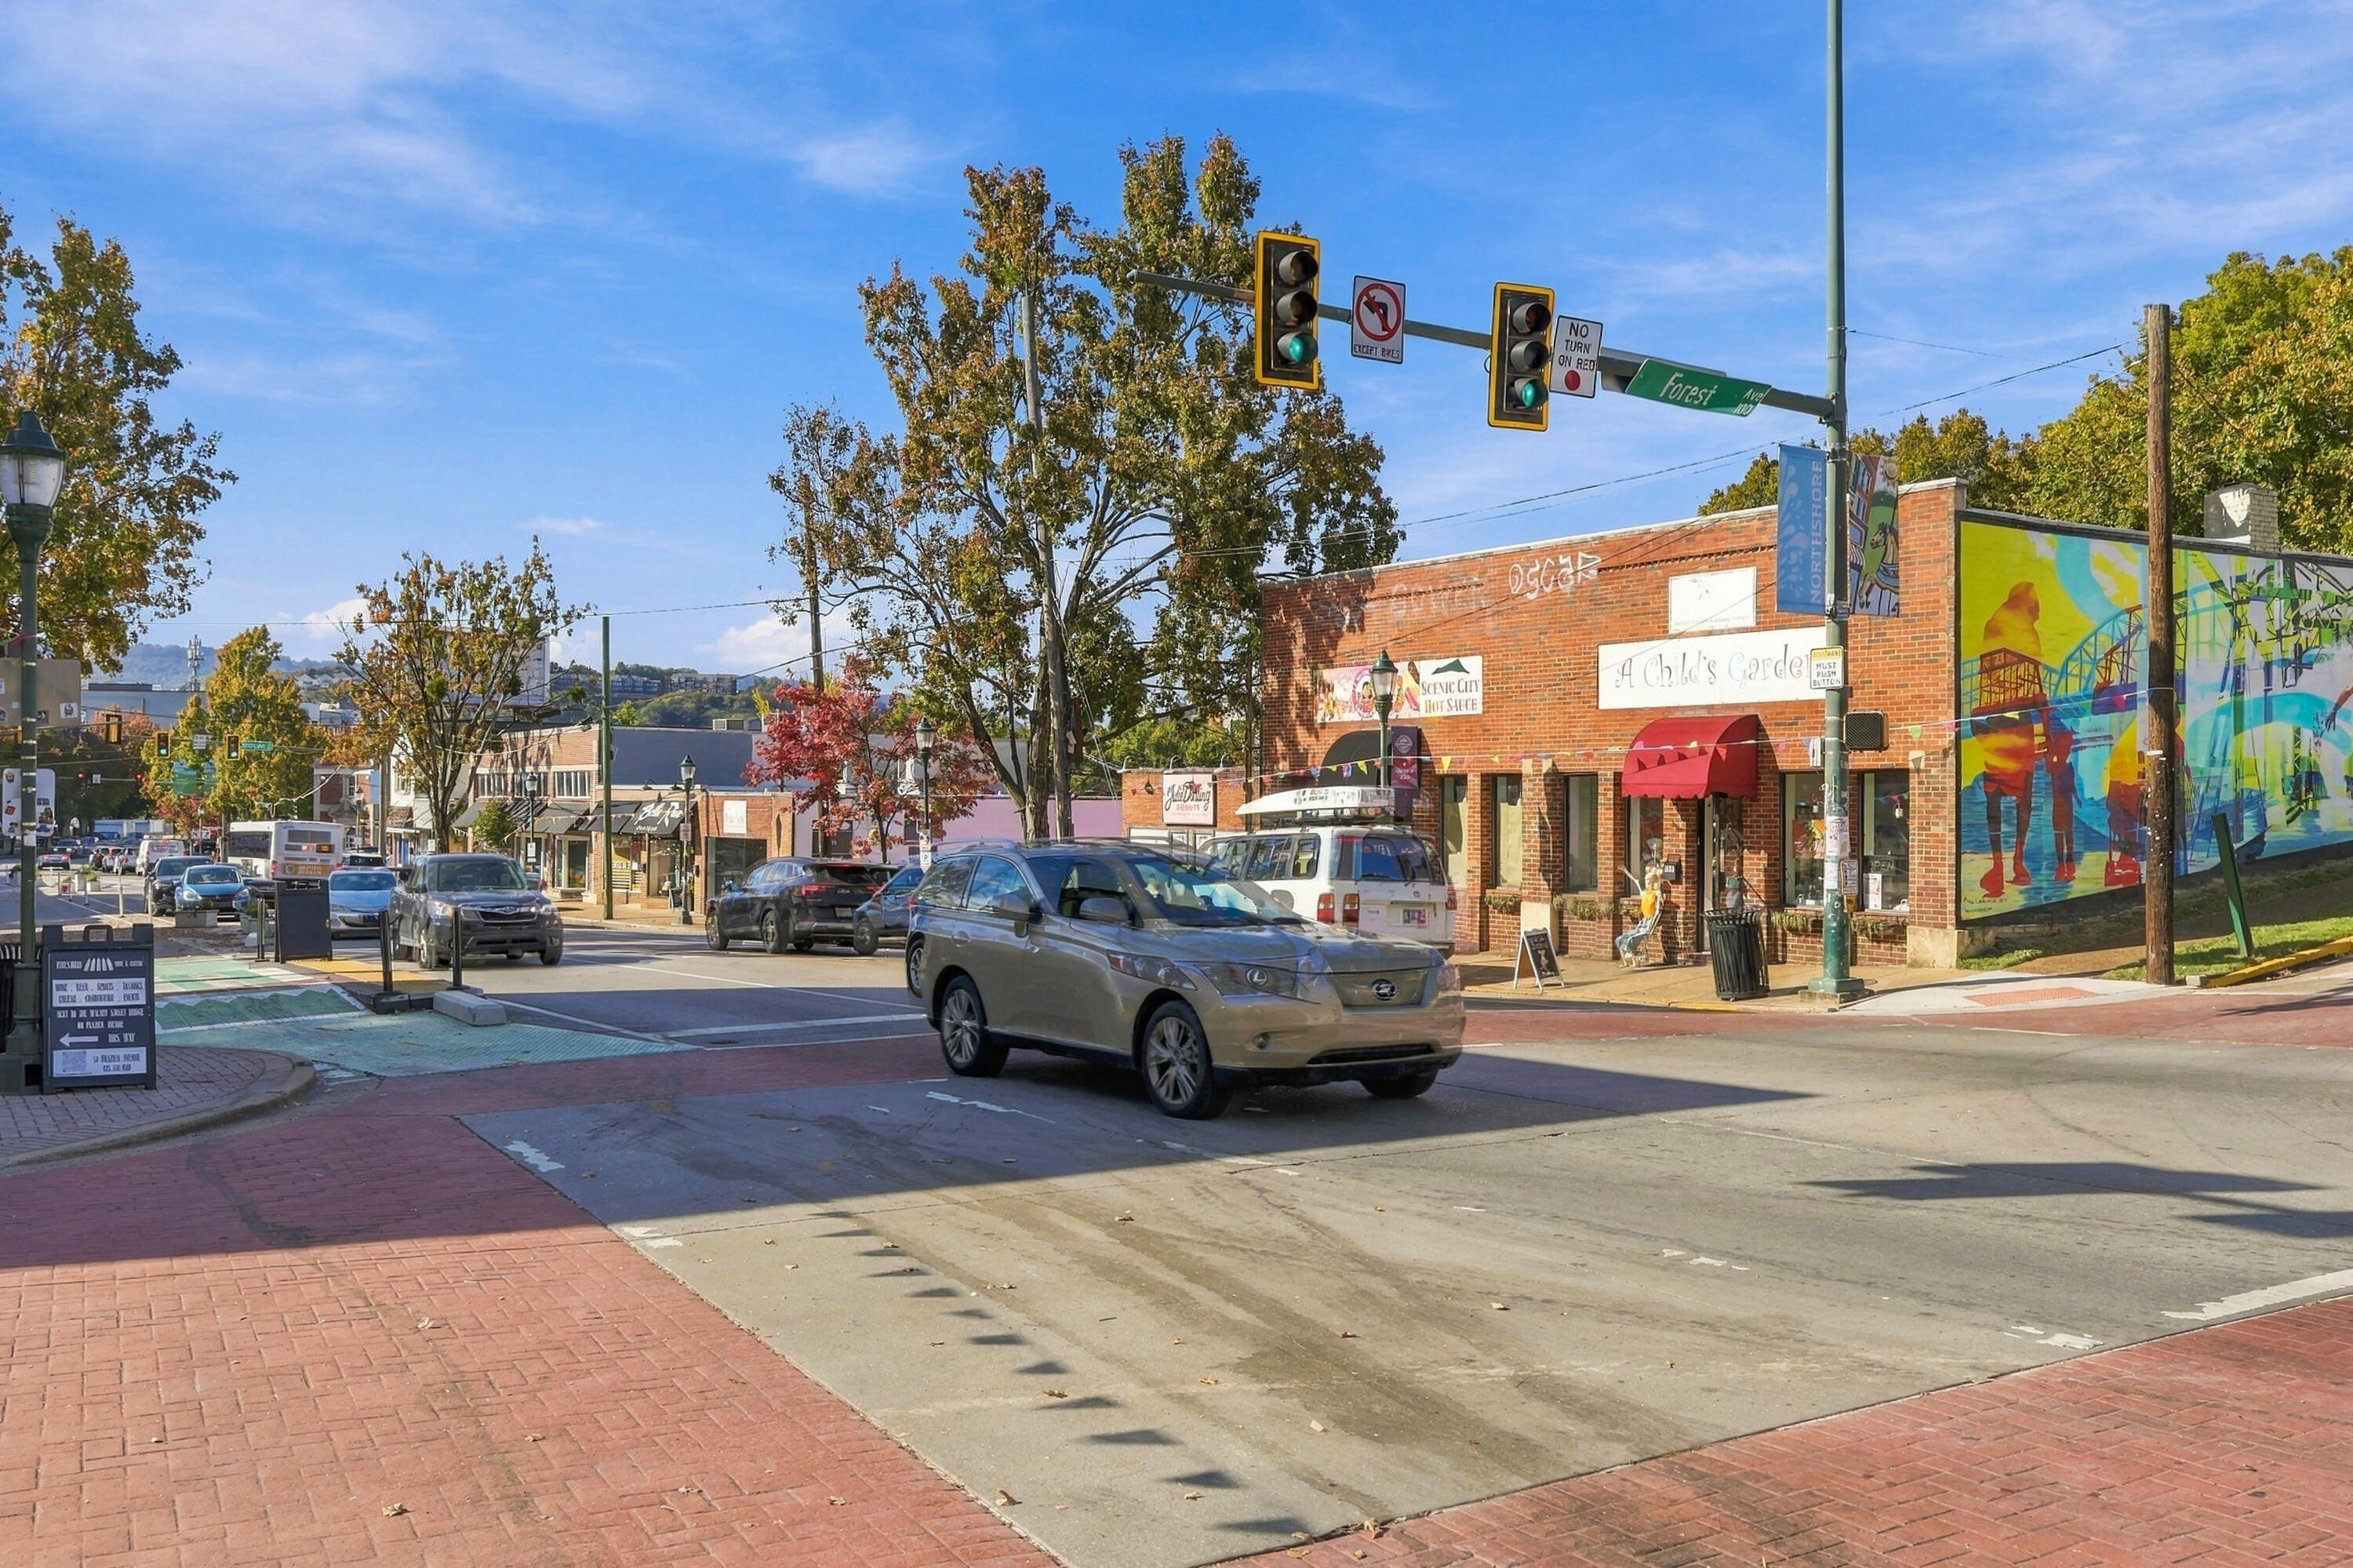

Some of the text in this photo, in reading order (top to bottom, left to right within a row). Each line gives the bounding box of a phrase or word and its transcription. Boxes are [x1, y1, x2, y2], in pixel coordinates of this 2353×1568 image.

[1569, 322, 1589, 338] NO
[1354, 344, 1400, 358] EXCEPT BIKES
[1565, 340, 1591, 355] TURN
[1558, 355, 1595, 371] ON RED
[1659, 372, 1718, 406] Forest
[1811, 460, 1822, 603] NORTHSHORE
[1615, 657, 1635, 688] A
[1643, 650, 1717, 688] Child's
